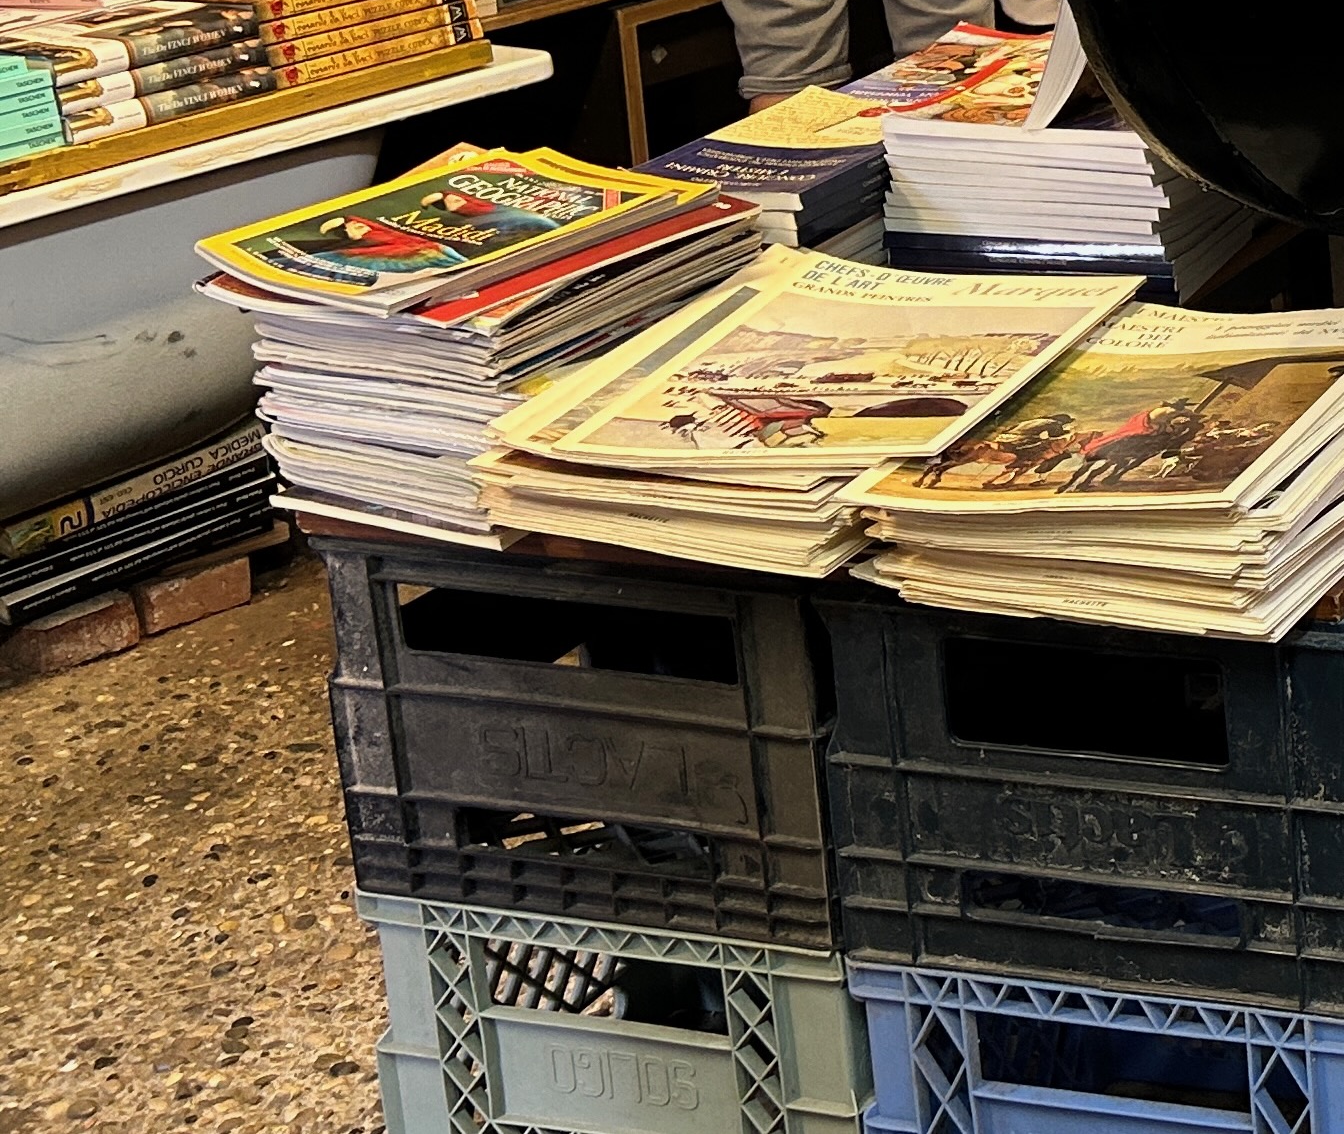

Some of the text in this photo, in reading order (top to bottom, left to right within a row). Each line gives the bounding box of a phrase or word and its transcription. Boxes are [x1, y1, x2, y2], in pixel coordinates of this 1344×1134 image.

[449, 174, 598, 216] GEOGRAPHIC
[499, 176, 594, 204] NATIONAL
[802, 270, 825, 282] DE
[791, 280, 934, 302] GRANDS PEINTRES
[952, 282, 1118, 301] Marquet
[153, 427, 261, 486] MEDICA CURCIO
